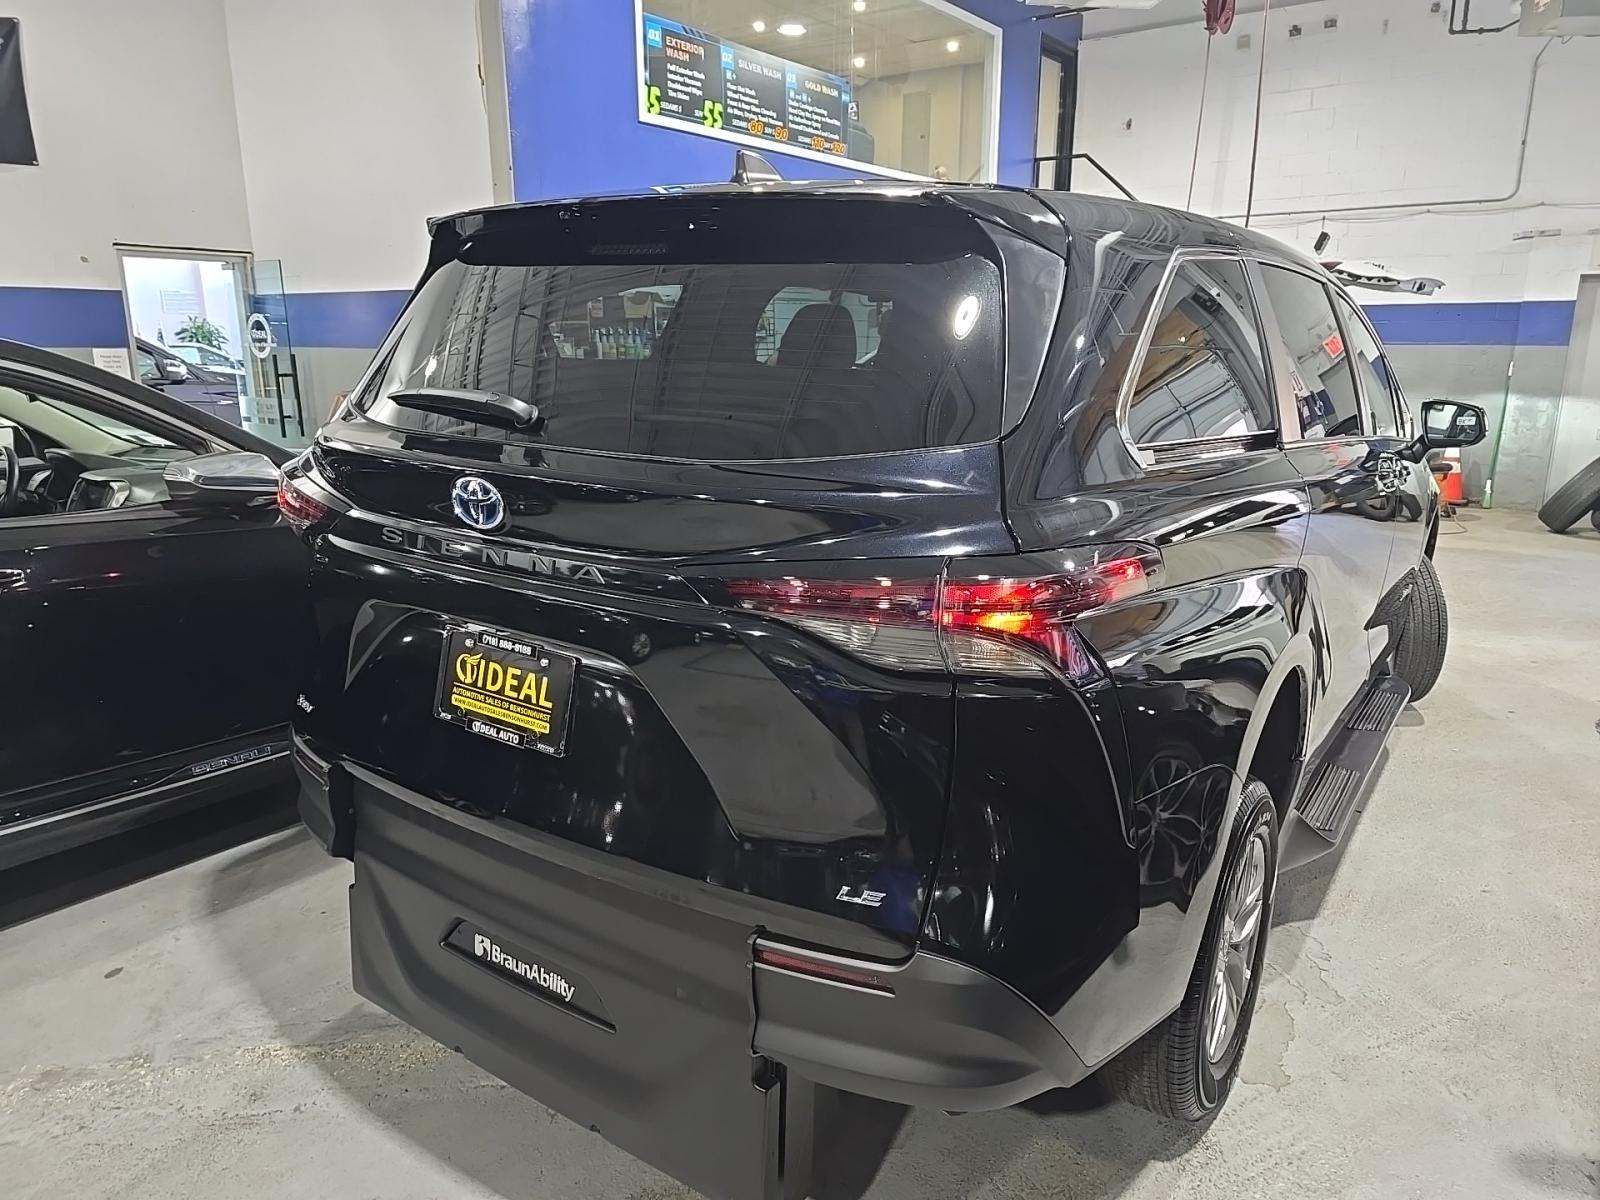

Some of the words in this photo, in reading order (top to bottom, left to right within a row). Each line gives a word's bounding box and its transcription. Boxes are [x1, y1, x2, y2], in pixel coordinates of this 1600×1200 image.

[665, 36, 705, 59] EXTERIOR
[665, 47, 690, 62] WASH
[722, 53, 734, 62] 02
[738, 59, 762, 74] SILVER
[762, 66, 782, 80] WASH
[804, 80, 821, 93] GOLD
[703, 100, 724, 129] 55
[382, 526, 605, 585] SIENNA
[477, 658, 553, 708] IDEAL
[452, 687, 485, 702] AUTOMOTIVE
[485, 695, 502, 707] SALES
[501, 700, 510, 709] OF
[509, 702, 551, 722] BENSONHURST
[498, 729, 519, 745] AUTO
[192, 746, 271, 776] DENALI
[835, 885, 887, 907] LE
[491, 944, 576, 1002] BraunAbility
